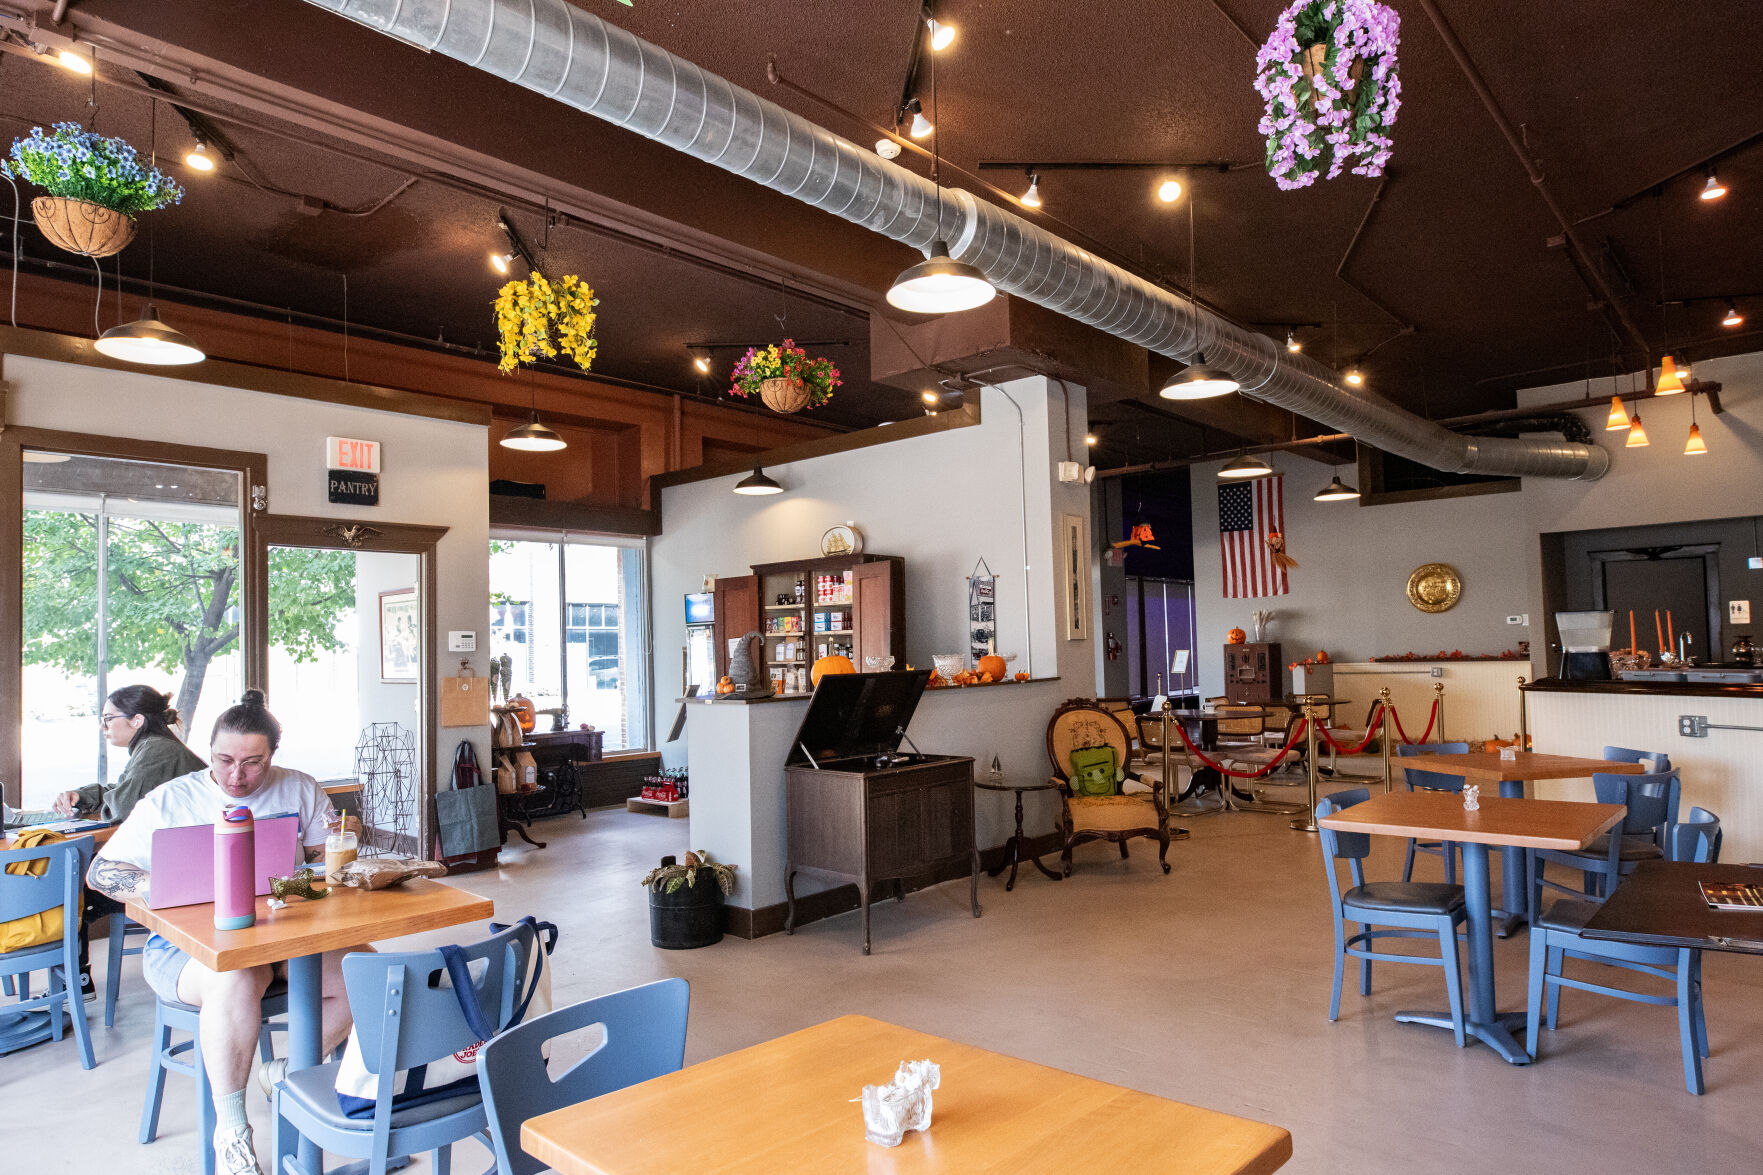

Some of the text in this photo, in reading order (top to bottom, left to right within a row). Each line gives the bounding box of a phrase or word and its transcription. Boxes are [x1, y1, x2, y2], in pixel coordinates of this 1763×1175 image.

[338, 439, 374, 469] EXIT
[330, 480, 377, 496] PANTRY
[460, 1049, 477, 1058] JOE
